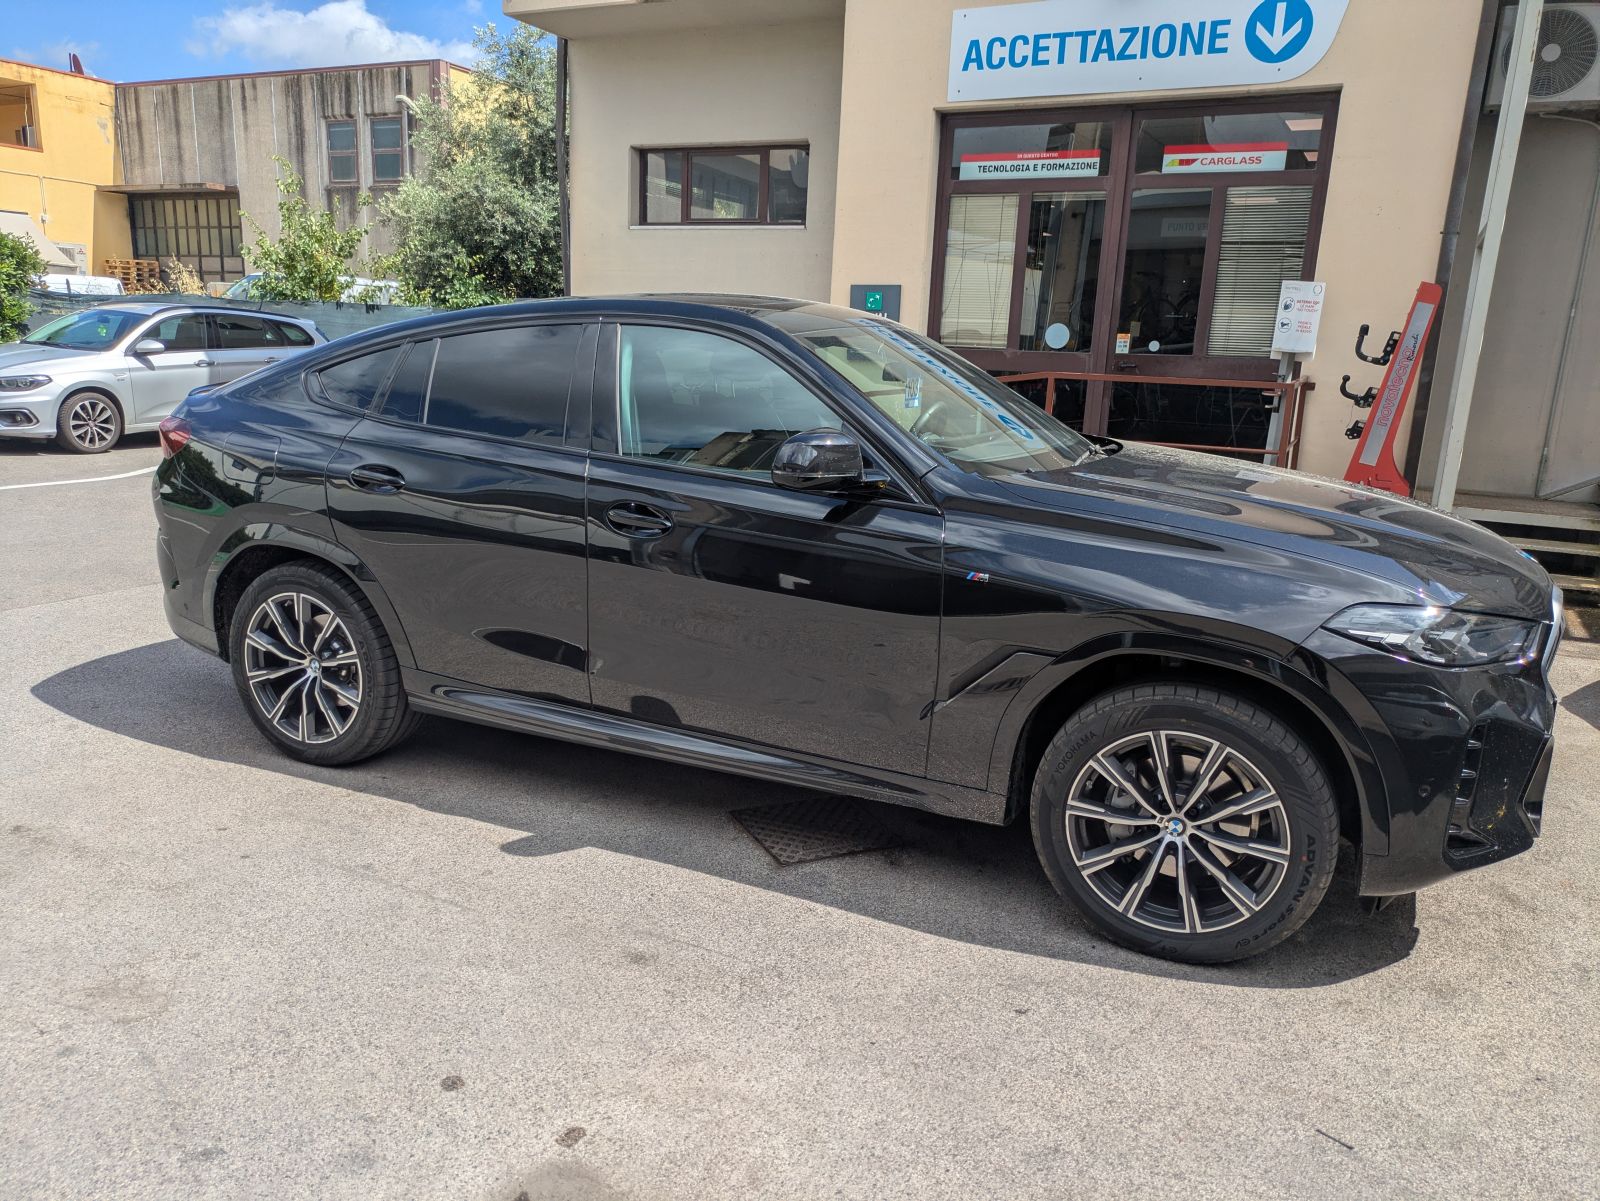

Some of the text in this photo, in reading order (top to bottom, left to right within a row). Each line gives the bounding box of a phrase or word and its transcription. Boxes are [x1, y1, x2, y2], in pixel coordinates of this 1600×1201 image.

[961, 19, 1232, 72] ACCETTAZIONE
[977, 161, 1098, 174] TECNOLOGIA E FORMAZIONE
[1200, 156, 1262, 166] CARGLASS
[1054, 731, 1097, 774] YOKOHAMA
[1292, 834, 1316, 903] ADVAN
